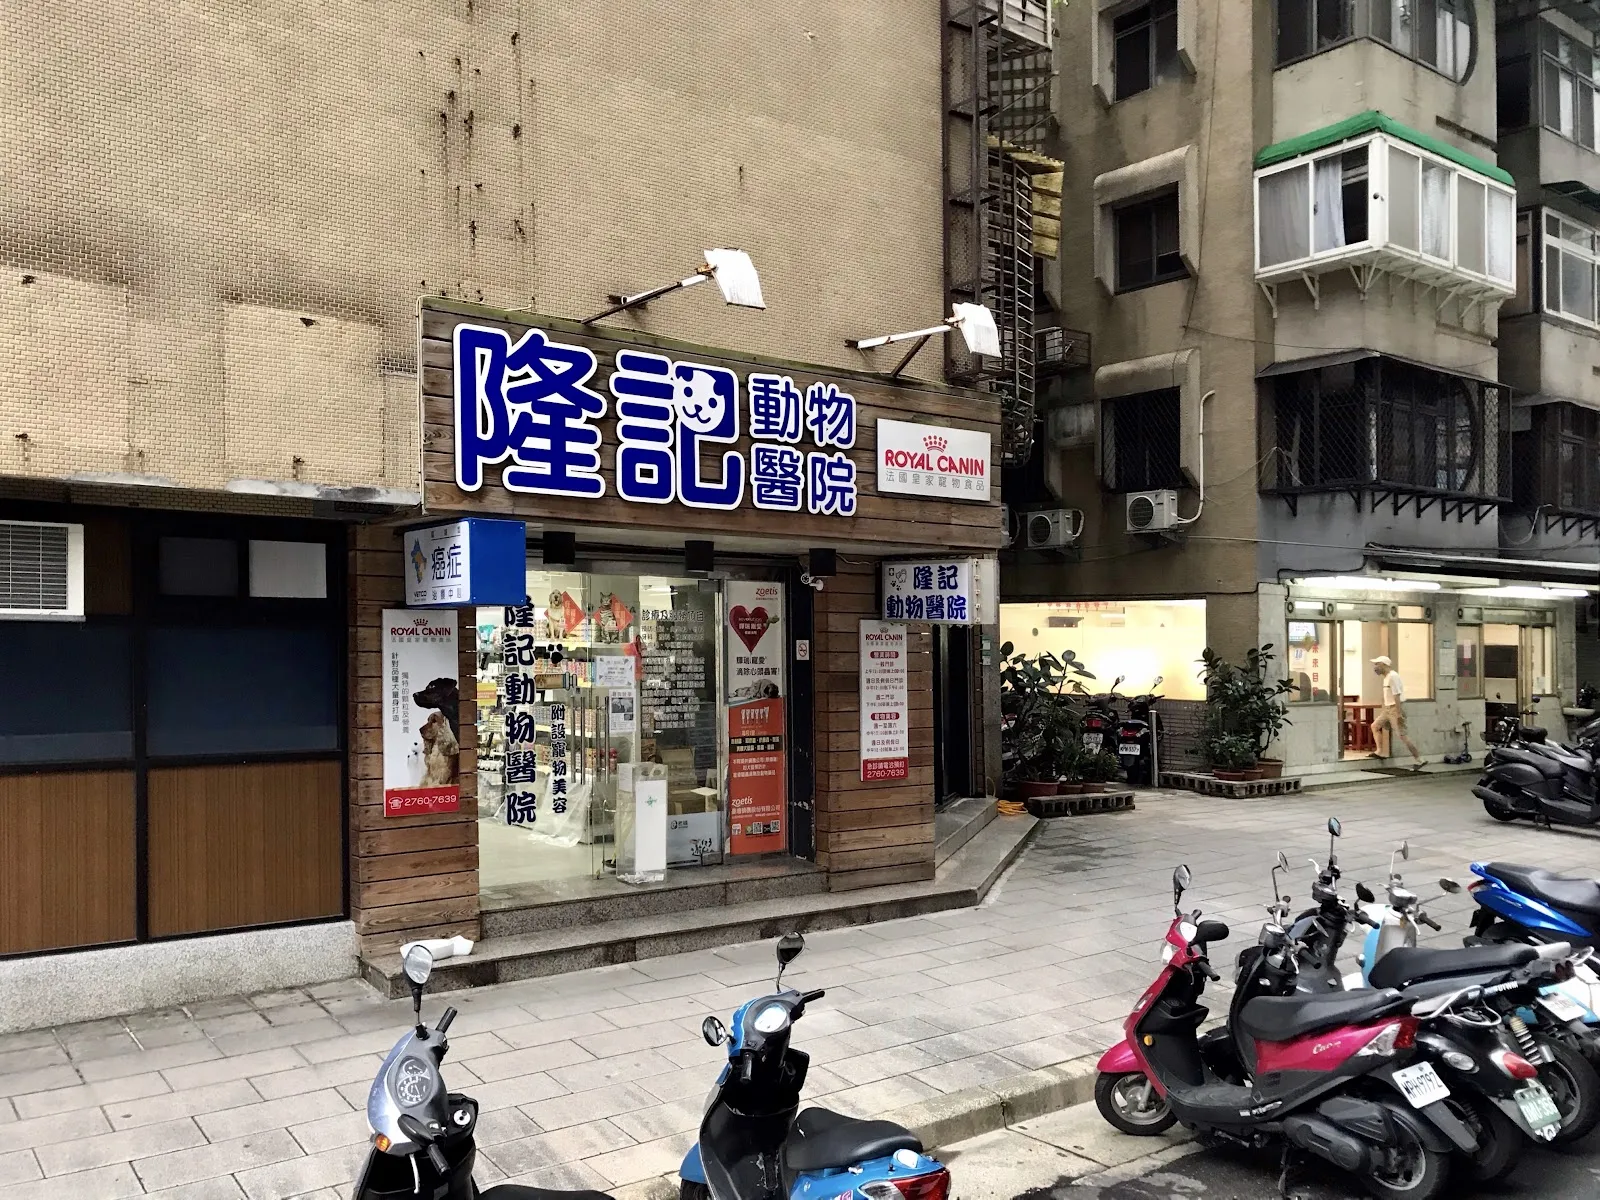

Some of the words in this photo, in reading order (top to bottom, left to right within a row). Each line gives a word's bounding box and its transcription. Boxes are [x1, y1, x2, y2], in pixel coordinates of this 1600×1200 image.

[453, 322, 743, 510] 隆記
[748, 373, 856, 448] 動物
[885, 449, 934, 472] ROYAL
[936, 454, 984, 477] CANIN
[752, 445, 857, 517] 醫院
[885, 471, 985, 492] 法國皇家寵物食品
[431, 543, 462, 580] 癌症
[912, 564, 960, 591] 隆記
[755, 586, 779, 597] zoetis
[885, 594, 967, 621] 動物醫院
[390, 626, 420, 637] ROYAL
[422, 625, 451, 637] CANIN
[865, 633, 884, 641] ROYAL
[884, 633, 903, 641] CANIN
[503, 595, 537, 826] 隆記動物醫院
[550, 703, 567, 815] 附設寵物美容
[866, 769, 905, 779] 2760-7639
[404, 794, 458, 808] 2760-7639
[731, 795, 753, 808] zoetis
